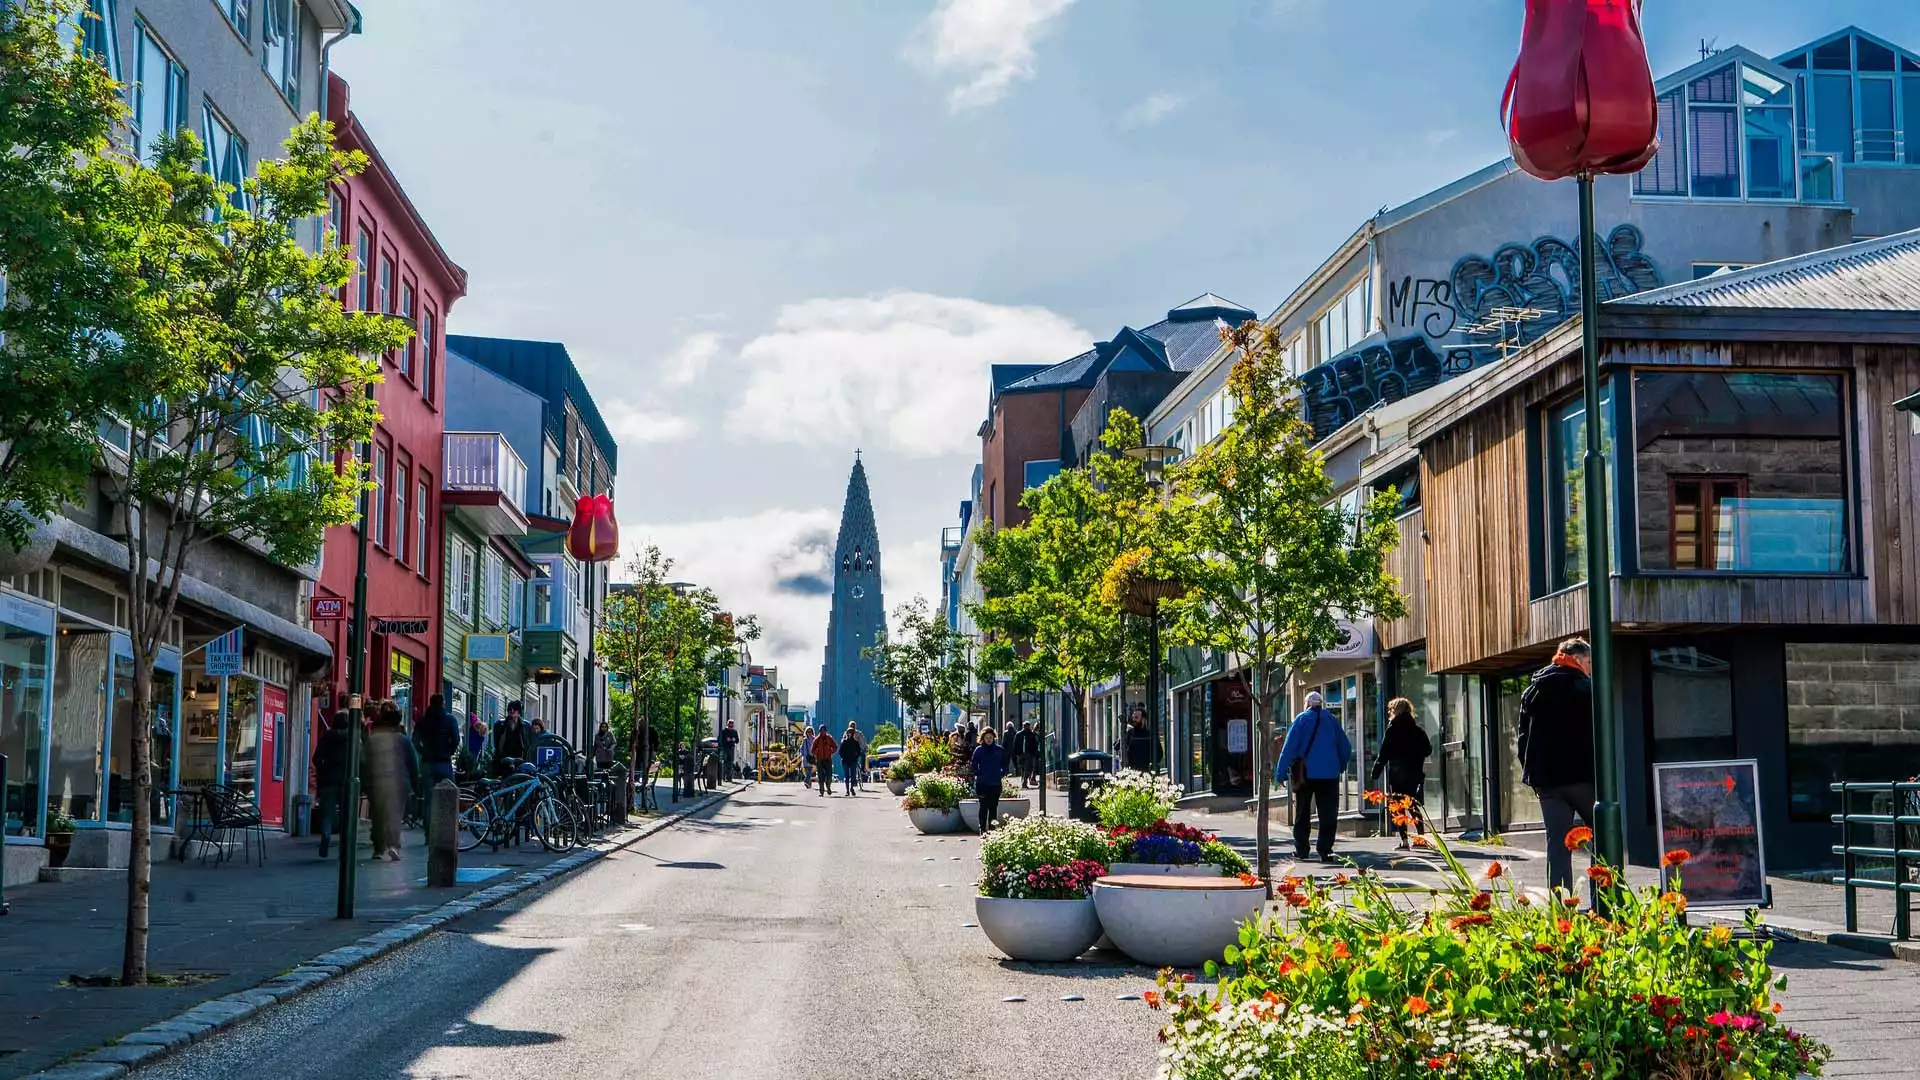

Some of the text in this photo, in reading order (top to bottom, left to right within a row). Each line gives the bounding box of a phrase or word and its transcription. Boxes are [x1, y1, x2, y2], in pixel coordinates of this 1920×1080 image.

[1389, 276, 1456, 338] MFS
[316, 600, 341, 611] ATM
[378, 619, 427, 635] MOKKA
[210, 655, 239, 663] TAX FREE
[545, 748, 555, 761] P
